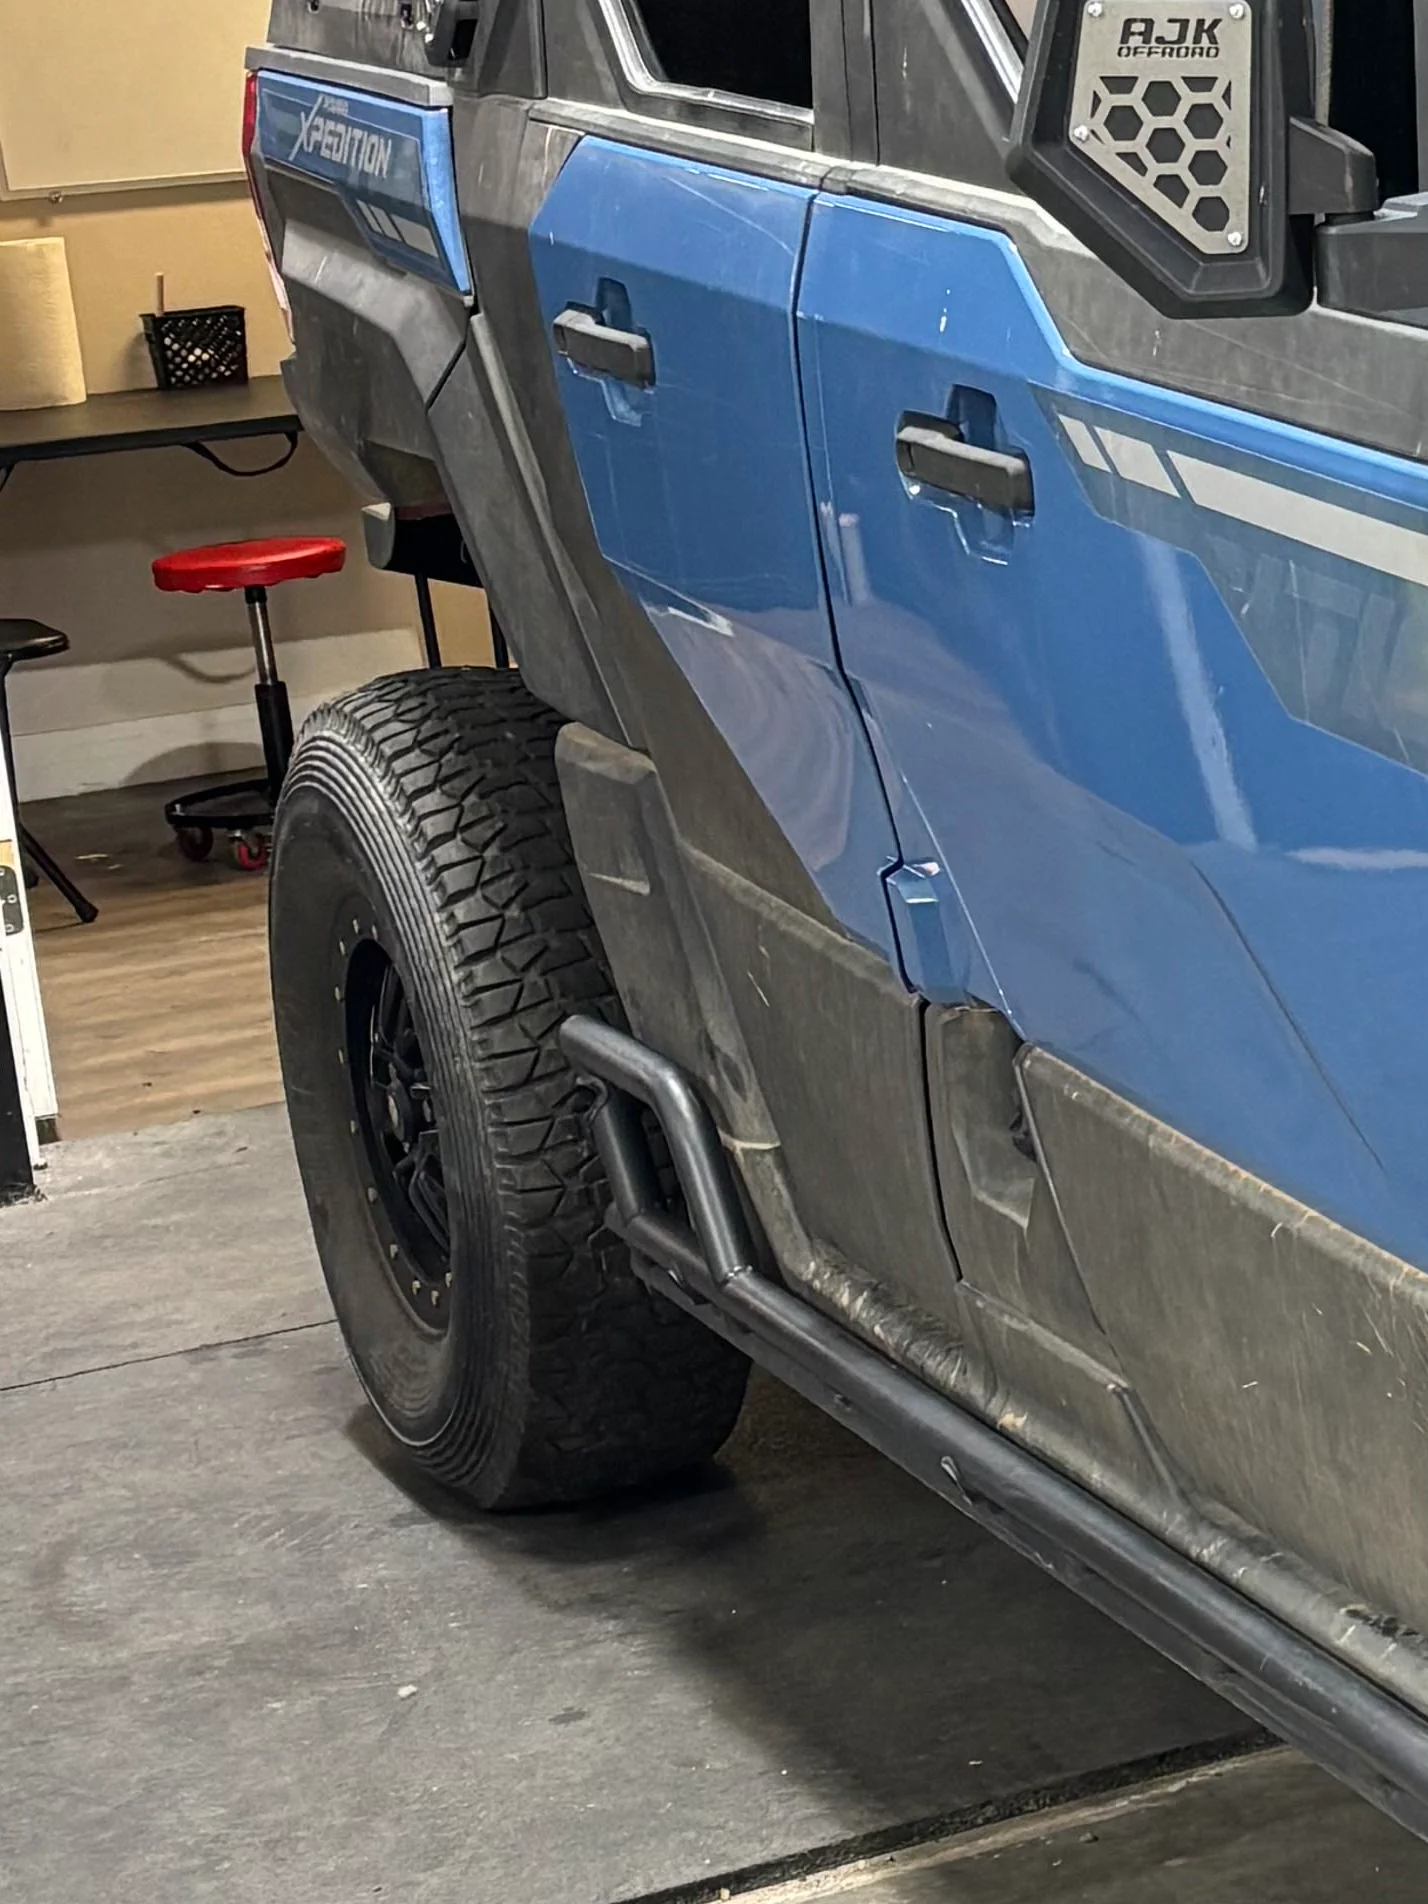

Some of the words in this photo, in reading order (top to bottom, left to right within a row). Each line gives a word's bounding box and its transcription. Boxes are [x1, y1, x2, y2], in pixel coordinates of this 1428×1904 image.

[1119, 17, 1222, 47] AJK
[1116, 46, 1220, 59] OFFROAD
[289, 93, 392, 178] XPEDITION
